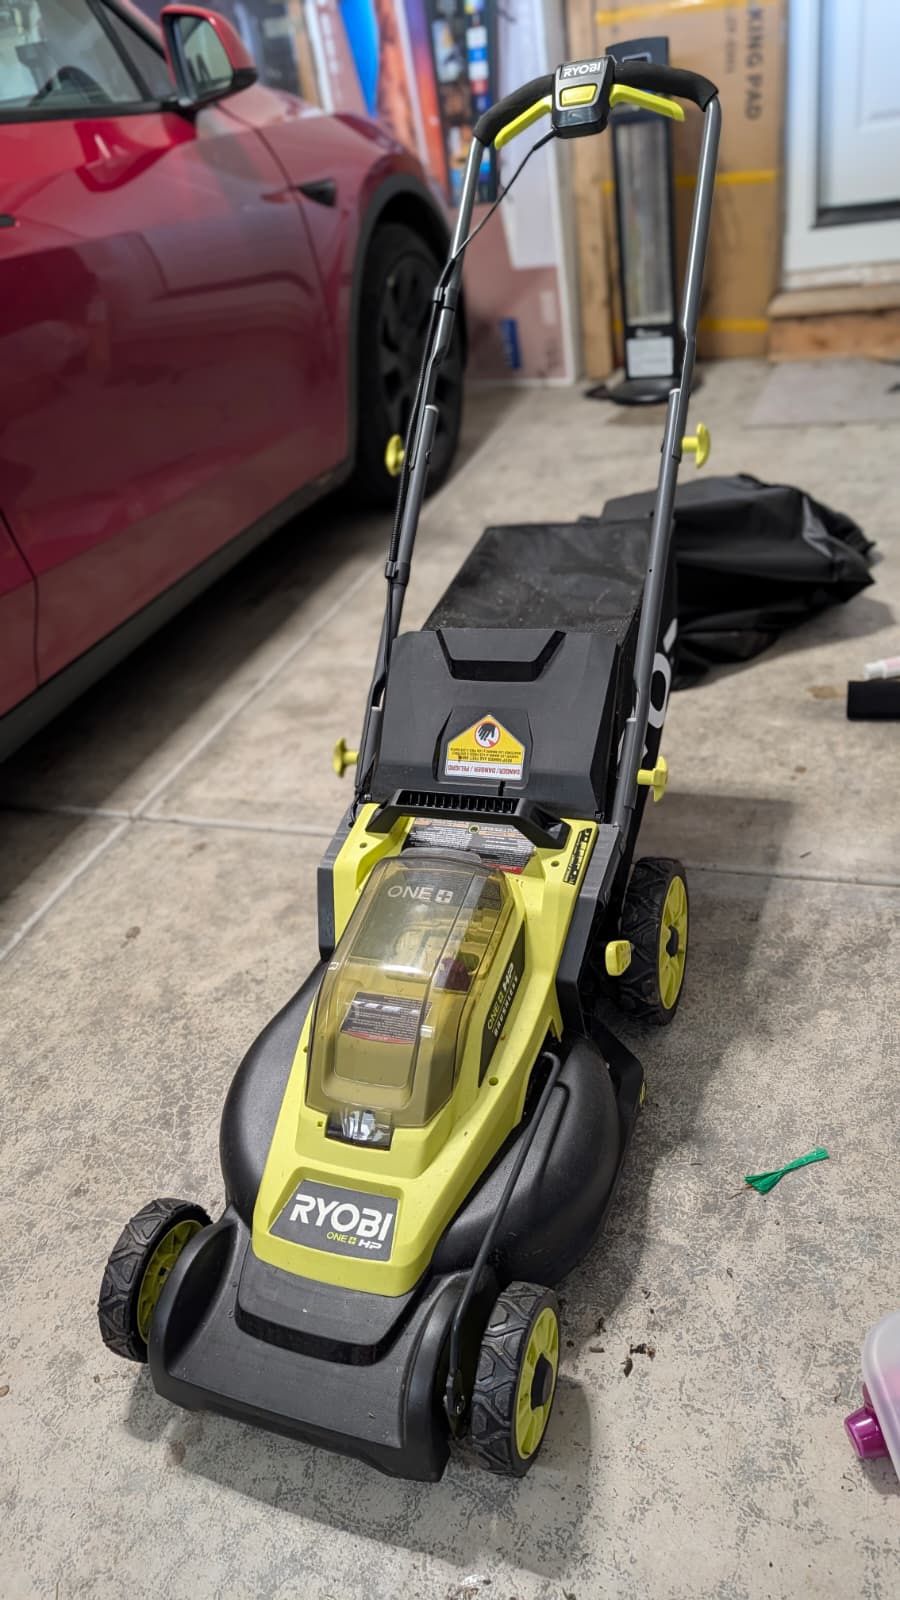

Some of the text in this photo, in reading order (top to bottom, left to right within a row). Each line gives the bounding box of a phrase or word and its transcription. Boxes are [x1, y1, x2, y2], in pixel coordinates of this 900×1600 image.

[563, 61, 601, 78] RYOBI
[746, 74, 764, 121] PAD
[502, 962, 515, 992] HP
[289, 1193, 394, 1241] RYOBI
[358, 1240, 383, 1249] HP
